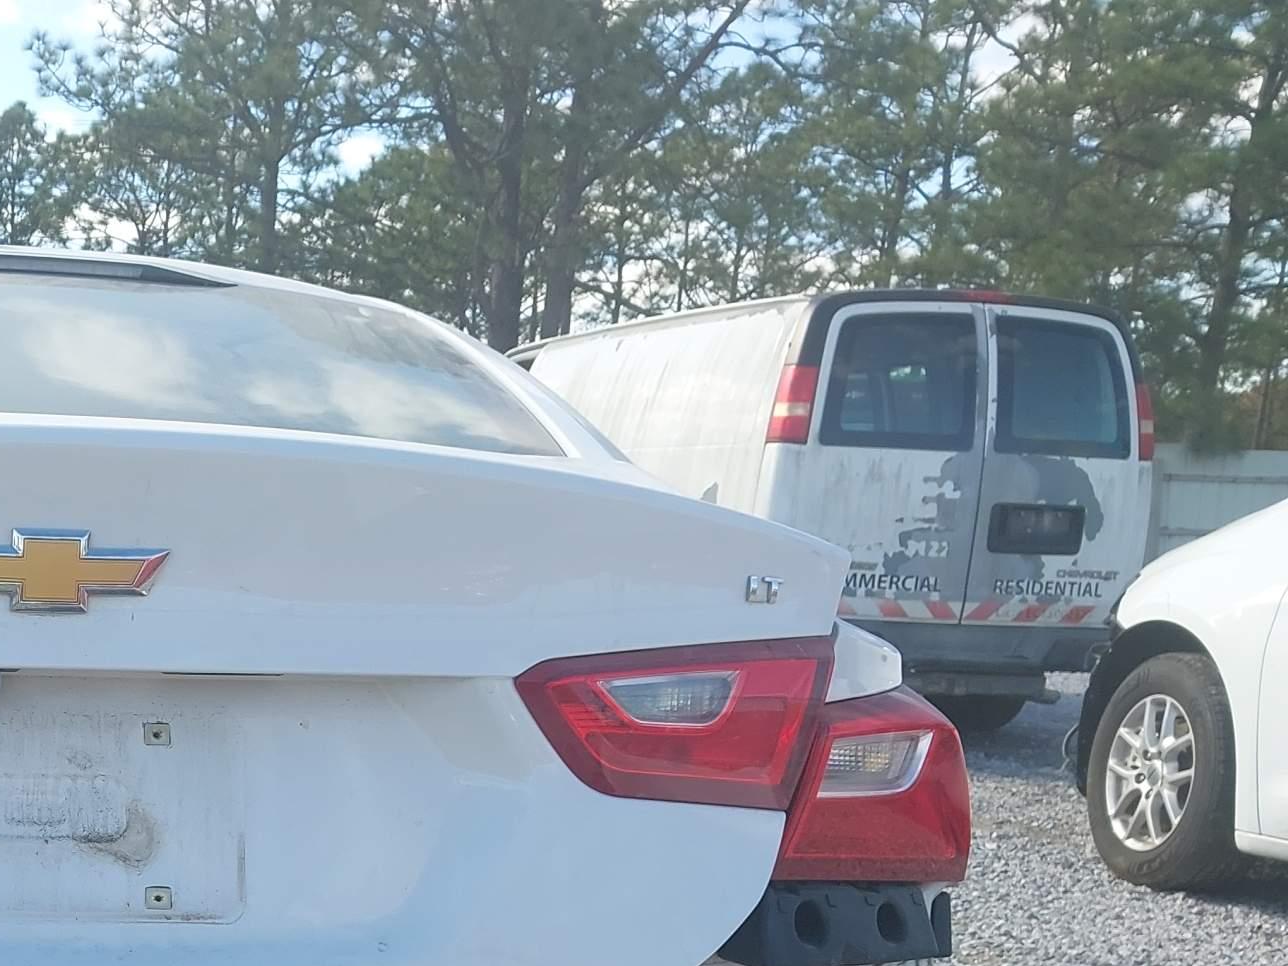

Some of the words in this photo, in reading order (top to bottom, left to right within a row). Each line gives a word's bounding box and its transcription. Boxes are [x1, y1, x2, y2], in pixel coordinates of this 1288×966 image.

[1056, 569, 1120, 581] CHEVROLET
[745, 575, 785, 605] LT
[993, 579, 1103, 598] RESIDENTIAL
